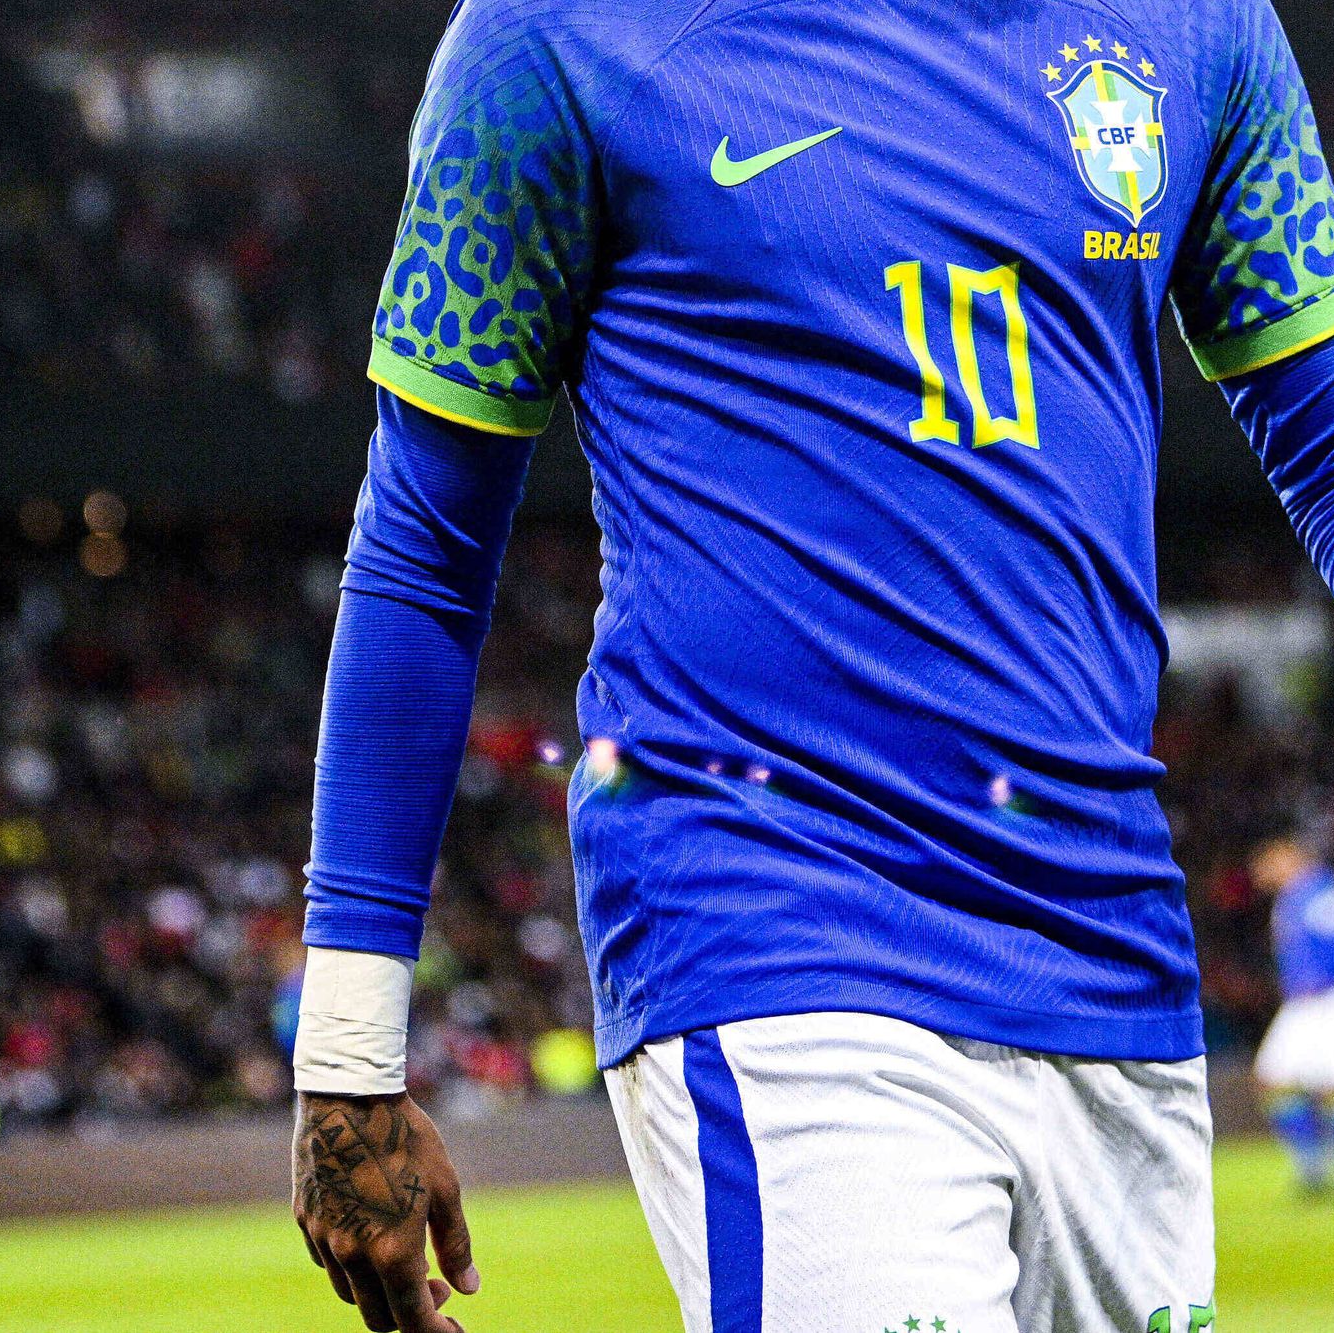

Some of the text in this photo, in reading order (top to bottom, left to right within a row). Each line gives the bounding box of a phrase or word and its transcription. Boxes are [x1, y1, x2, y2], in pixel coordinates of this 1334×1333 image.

[1097, 126, 1135, 145] CBF
[1083, 229, 1161, 260] BRASIL
[884, 260, 1040, 450] 10
